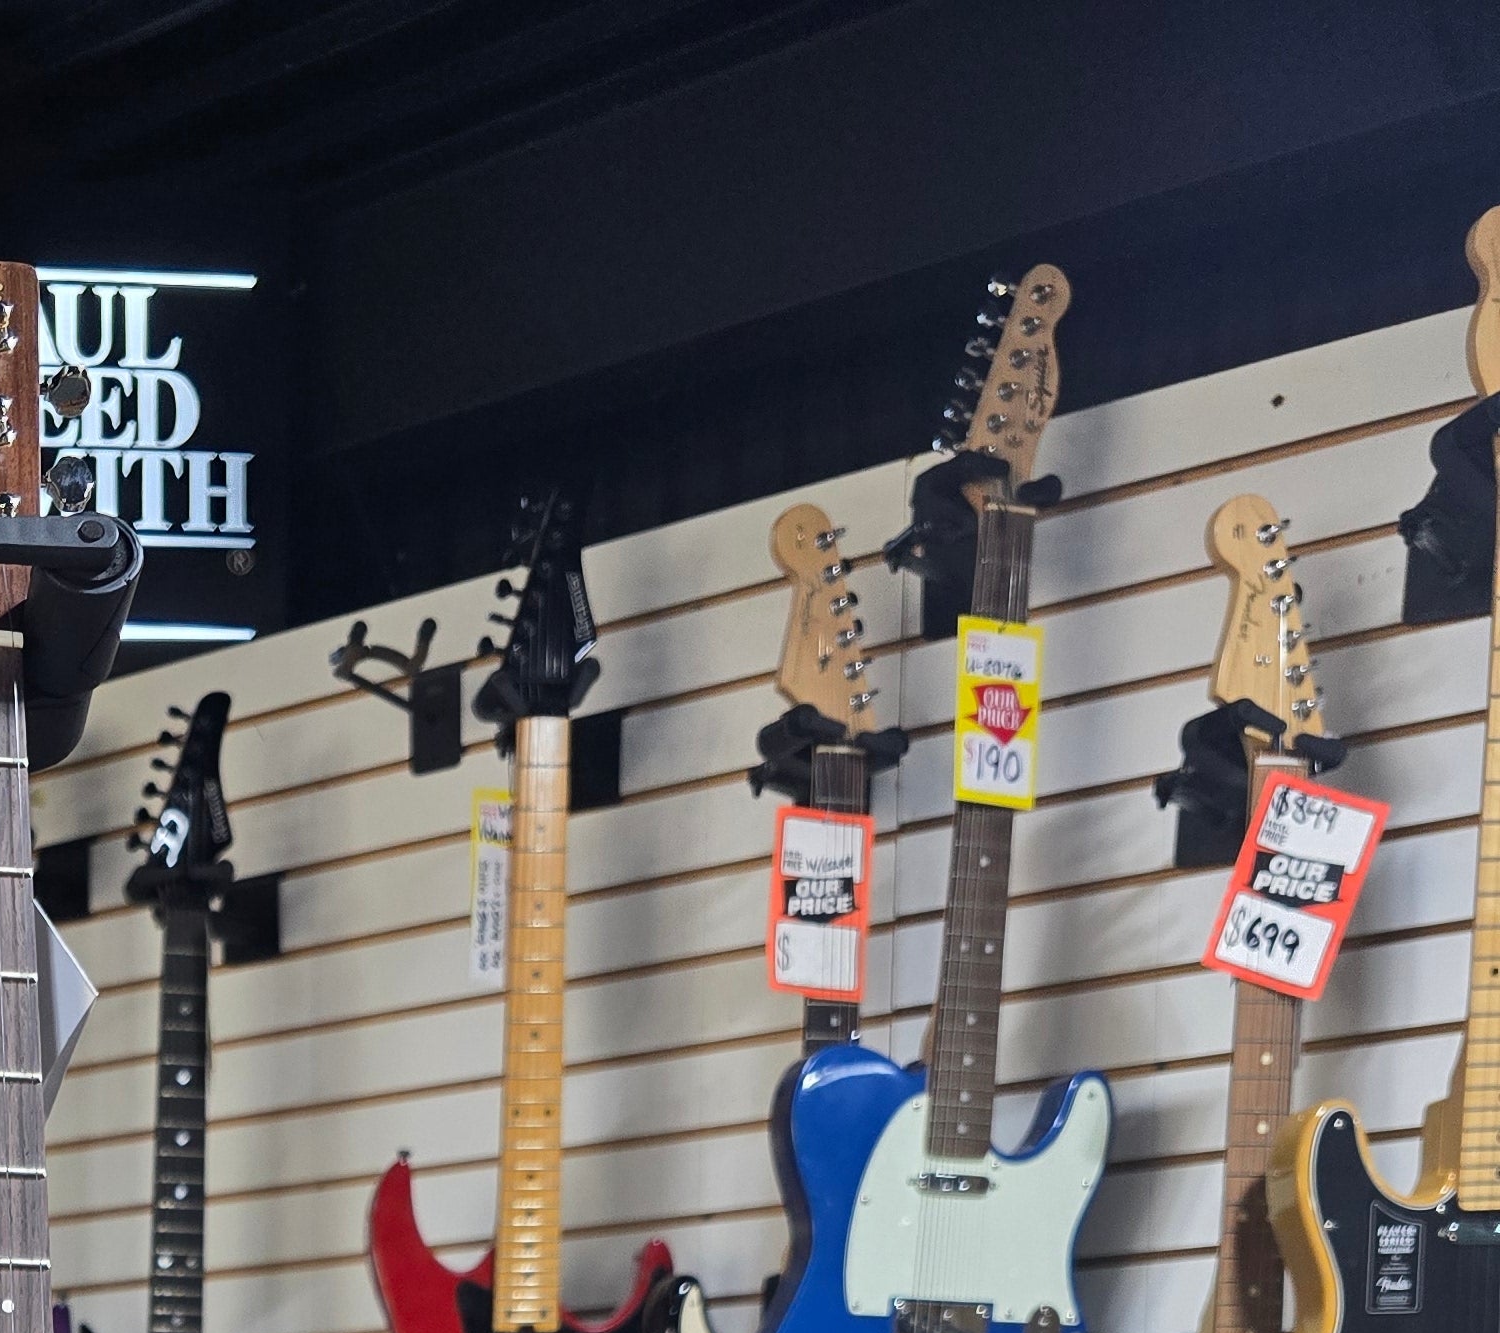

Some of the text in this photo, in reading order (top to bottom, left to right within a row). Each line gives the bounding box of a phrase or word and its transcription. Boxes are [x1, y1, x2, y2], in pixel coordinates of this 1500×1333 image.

[38, 449, 255, 533] ITH
[982, 686, 1017, 710] OUR
[977, 707, 1023, 732] PRICE
[1267, 854, 1330, 883] OUR
[795, 879, 845, 899] OUR
[1252, 870, 1338, 903] PRICE
[787, 895, 854, 919] PRICE
[1223, 905, 1300, 966] $699
